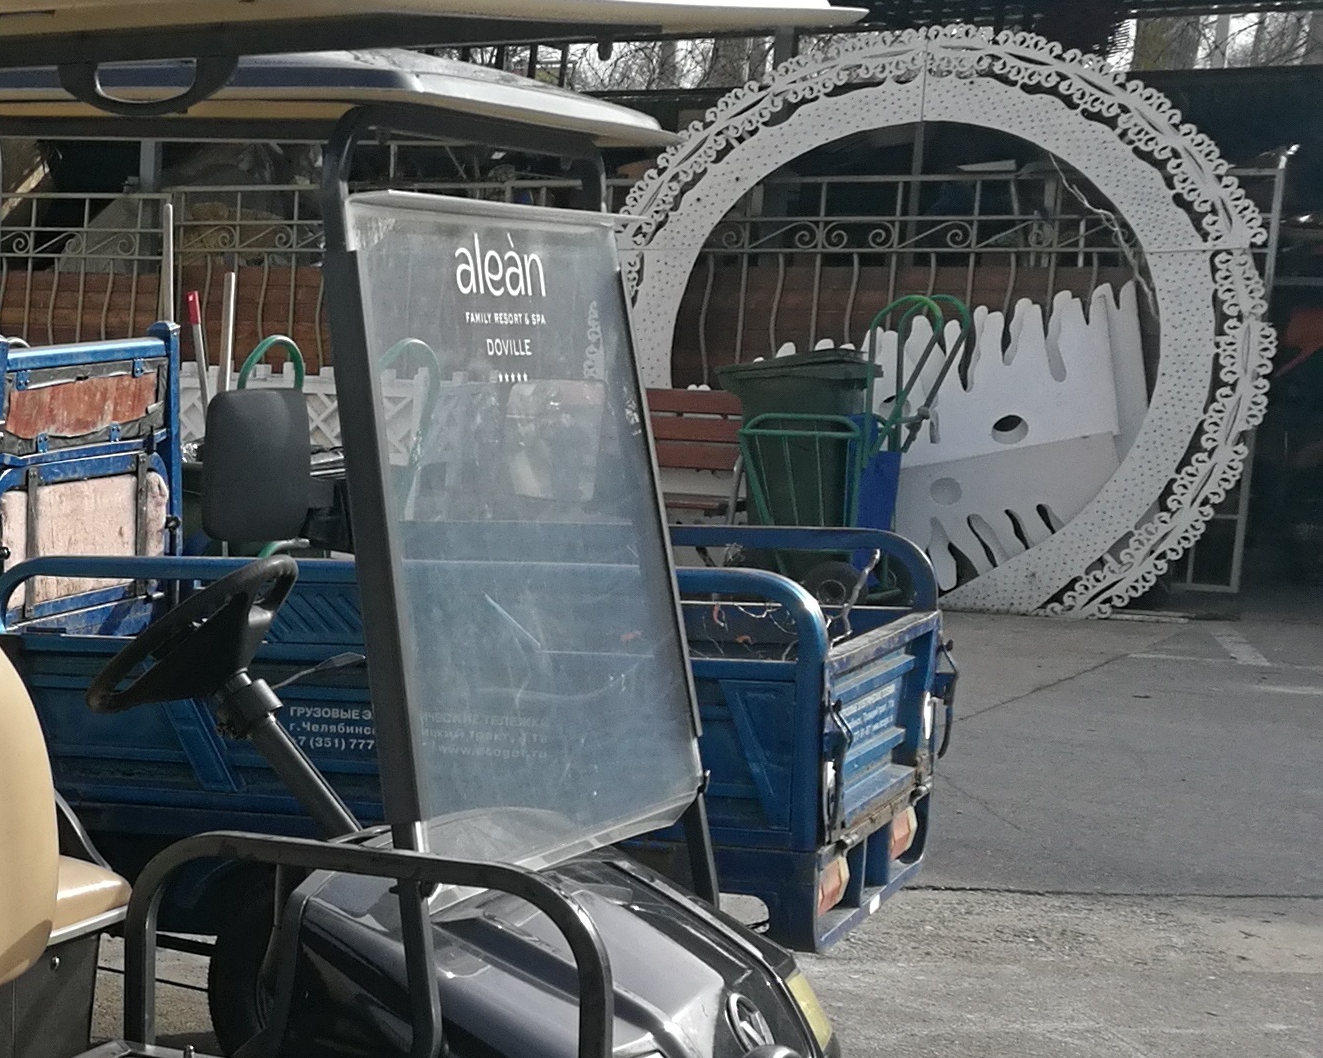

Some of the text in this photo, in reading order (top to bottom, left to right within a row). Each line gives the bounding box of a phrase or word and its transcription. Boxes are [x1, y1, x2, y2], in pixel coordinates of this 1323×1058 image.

[454, 232, 547, 297] aleàn
[465, 311, 546, 325] FAMILY RESORT & SPA
[486, 338, 532, 356] DOVILLE
[289, 706, 361, 720] ГРУЗОВЫЕ
[309, 737, 346, 750] (351)
